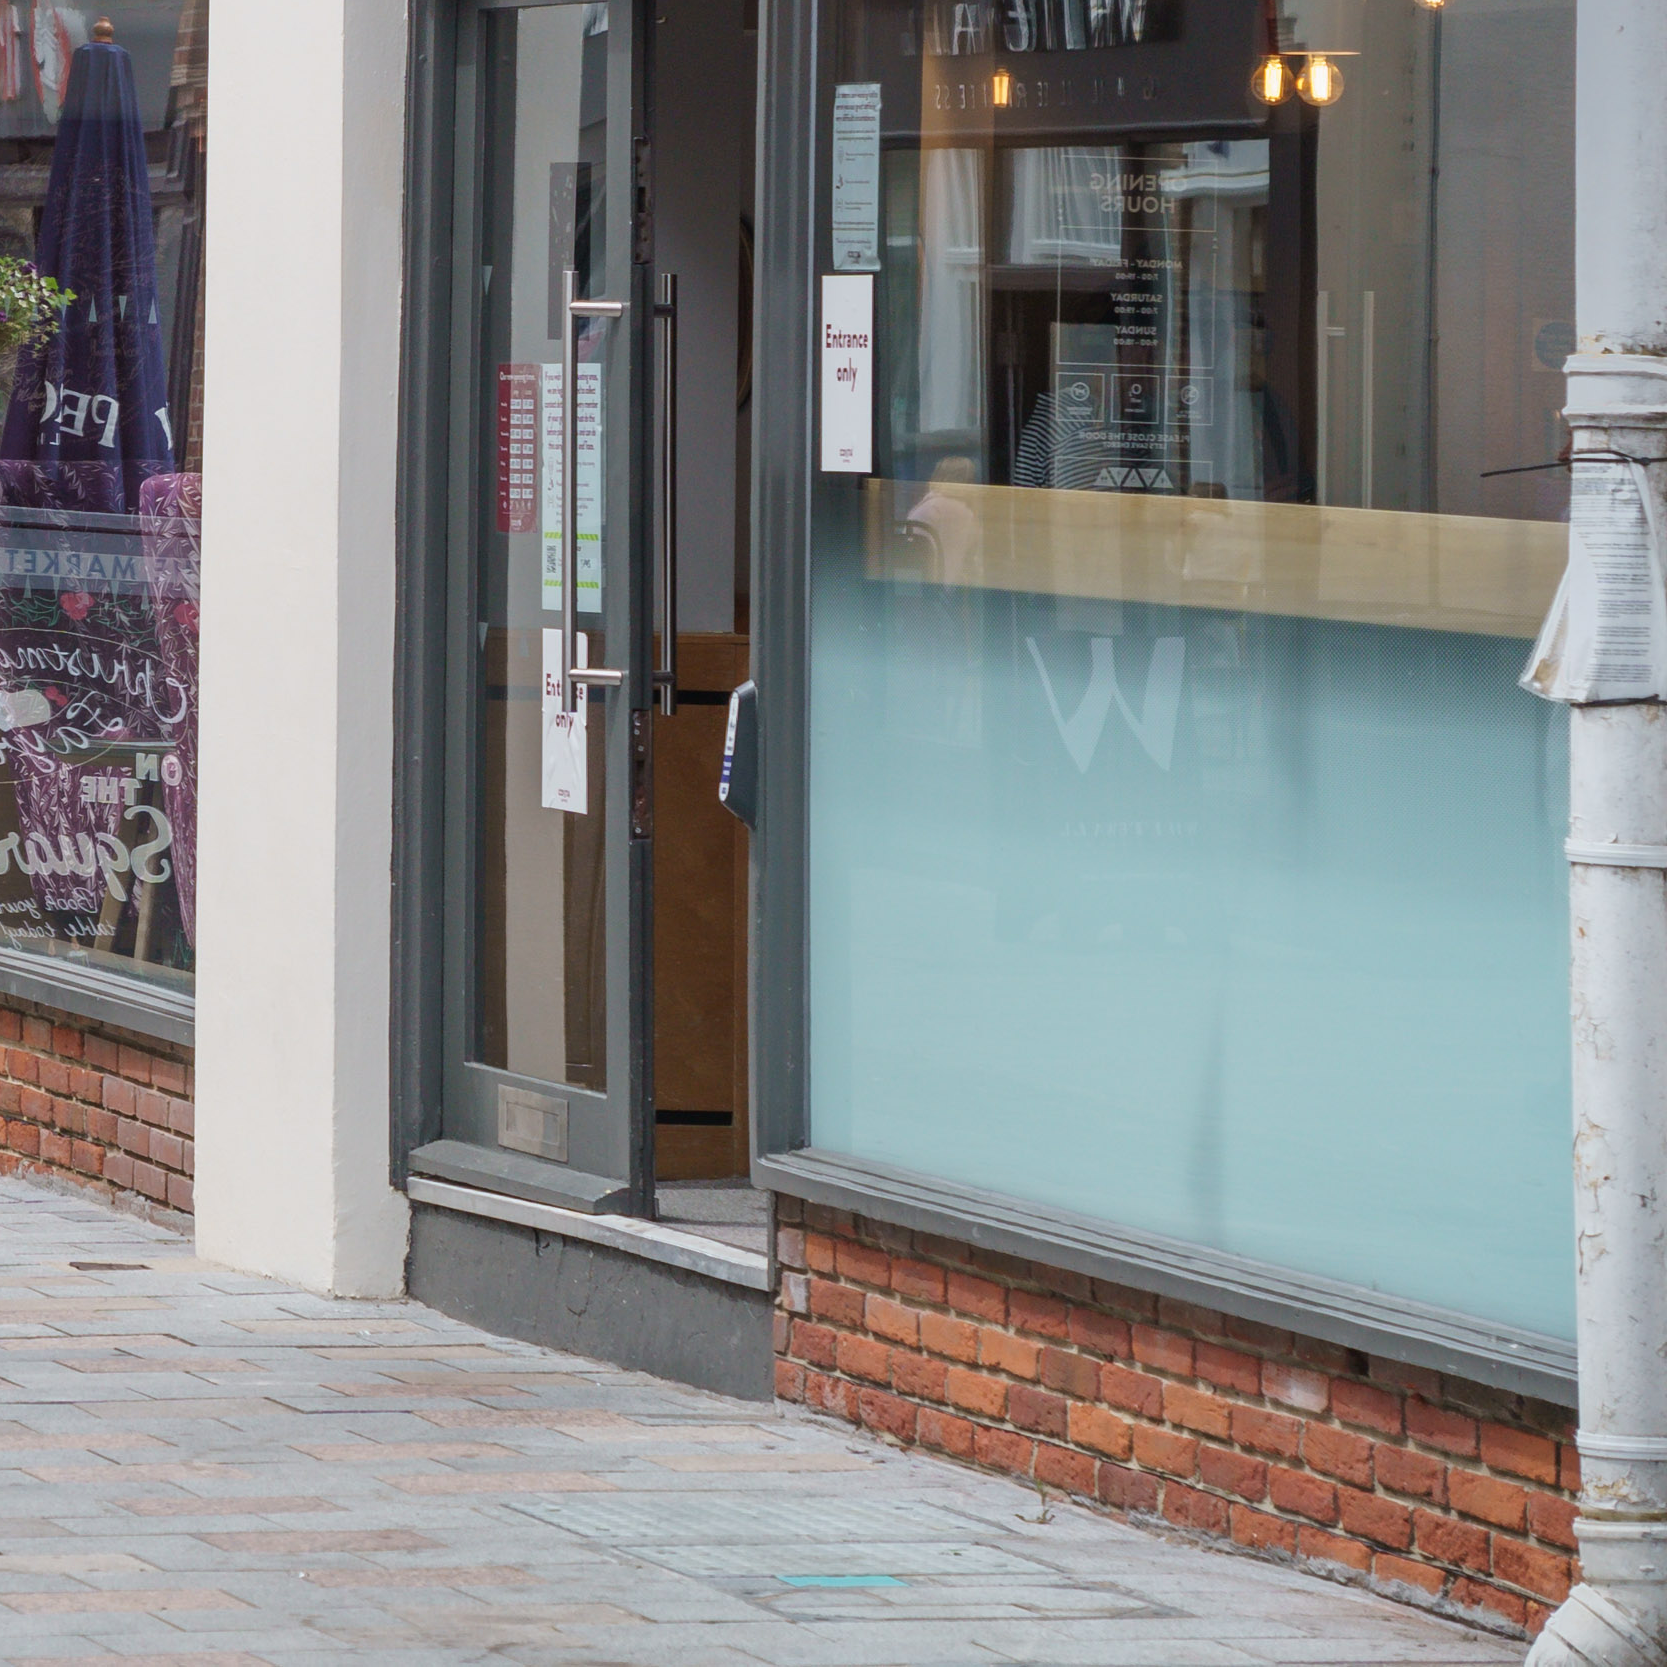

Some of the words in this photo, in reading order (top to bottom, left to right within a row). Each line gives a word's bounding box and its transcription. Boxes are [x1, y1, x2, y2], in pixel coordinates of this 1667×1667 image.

[825, 324, 869, 349] Entrance
[836, 357, 858, 393] only
[555, 712, 574, 739] only
